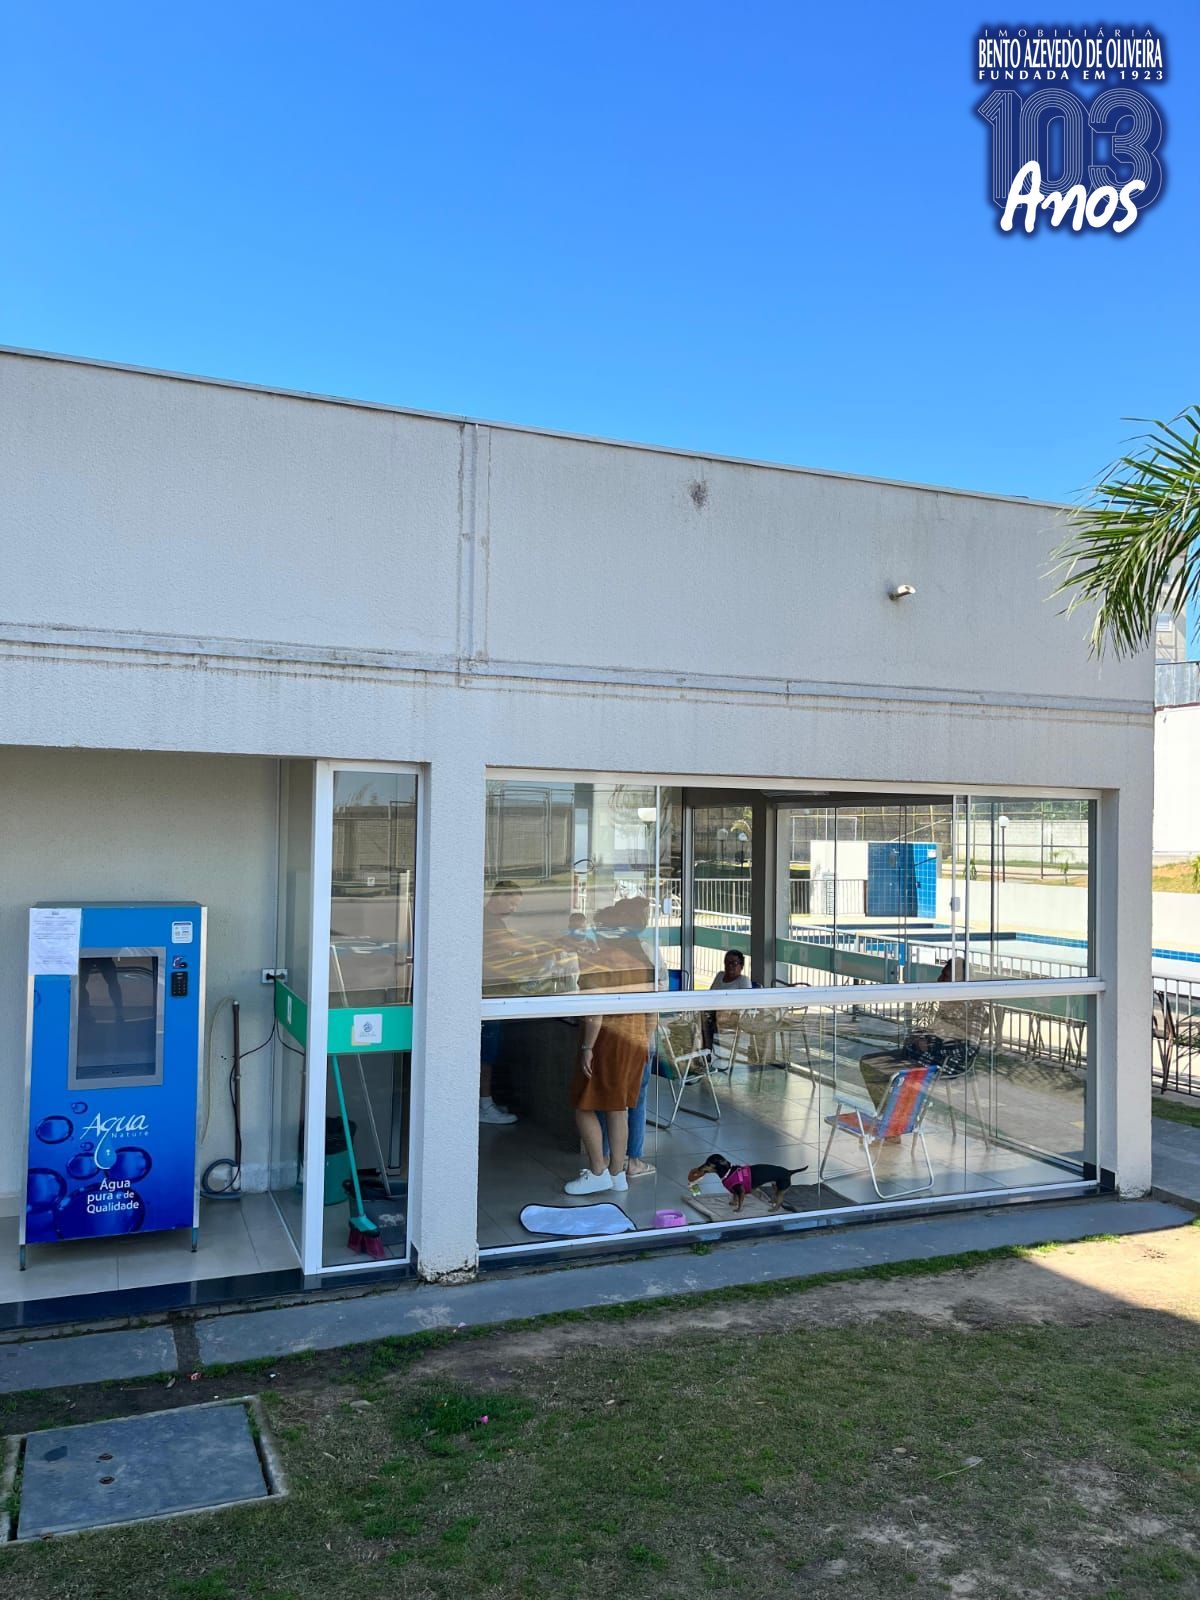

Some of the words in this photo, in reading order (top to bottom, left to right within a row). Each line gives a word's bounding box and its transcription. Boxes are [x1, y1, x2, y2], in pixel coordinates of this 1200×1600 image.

[87, 1192, 113, 1204] pura
[123, 1190, 135, 1199] de
[86, 1200, 140, 1215] Qualidade
